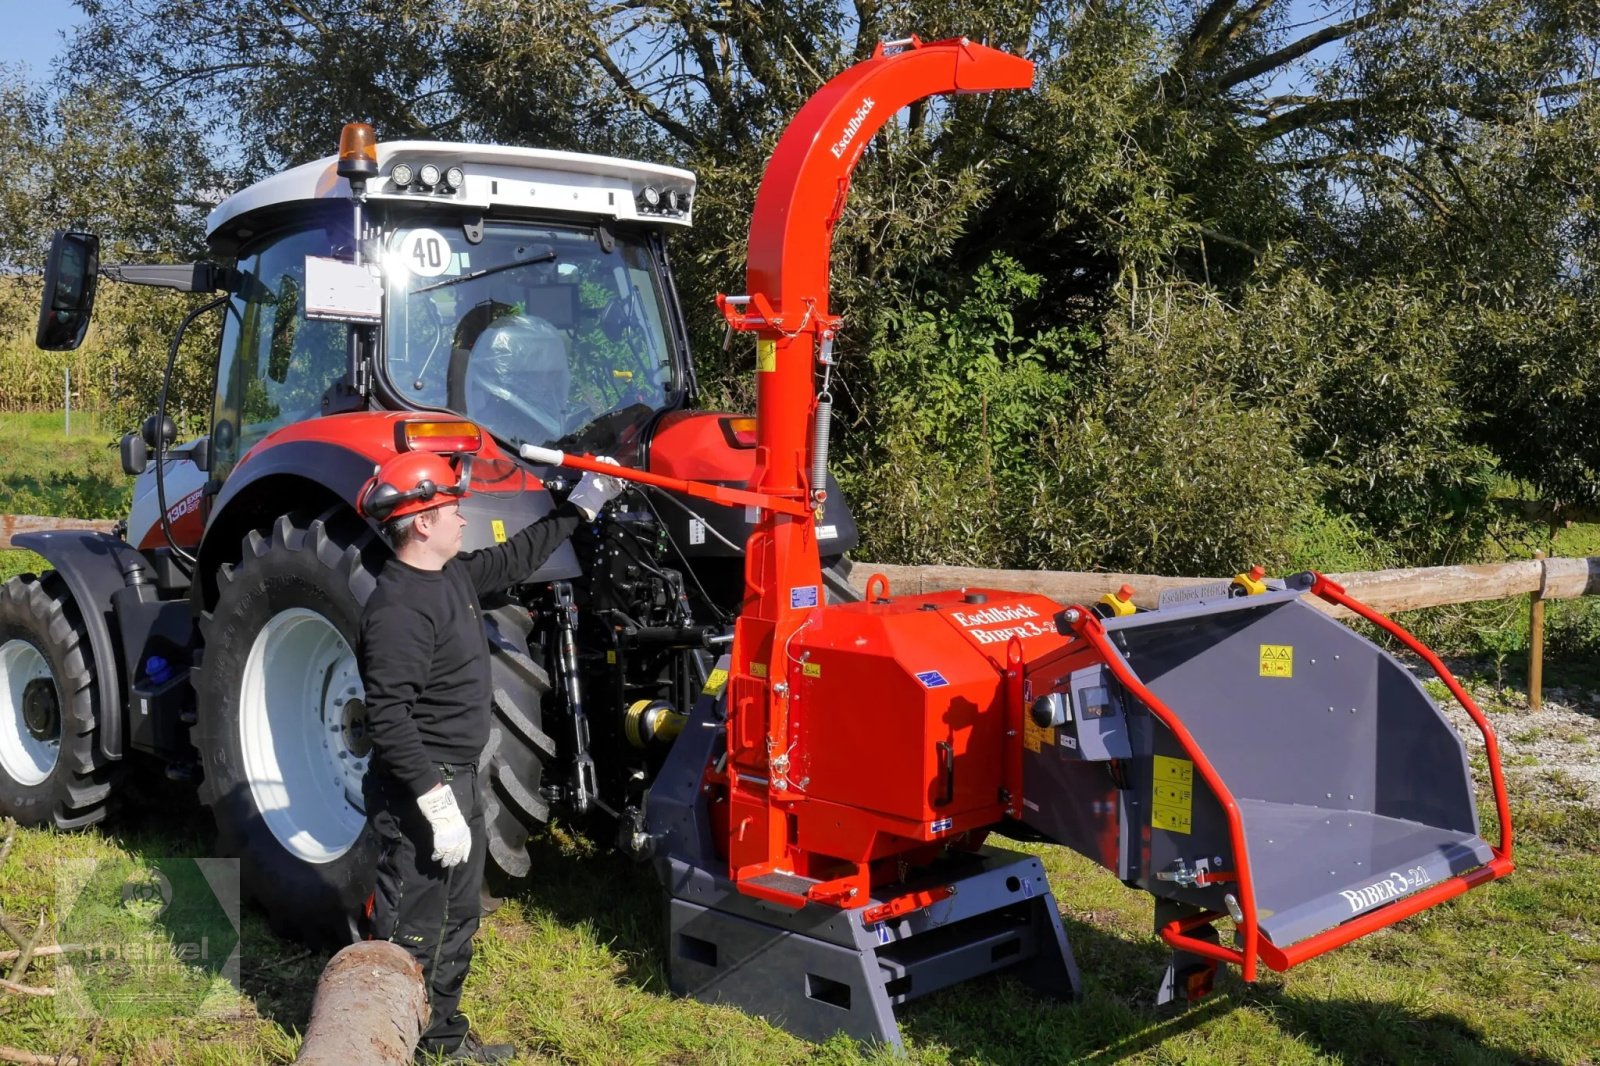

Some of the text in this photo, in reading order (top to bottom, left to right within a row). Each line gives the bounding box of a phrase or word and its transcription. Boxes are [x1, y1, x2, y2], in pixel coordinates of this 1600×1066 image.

[830, 96, 875, 159] Eschlböck
[413, 238, 441, 267] 40
[951, 604, 1039, 627] Eschlböck
